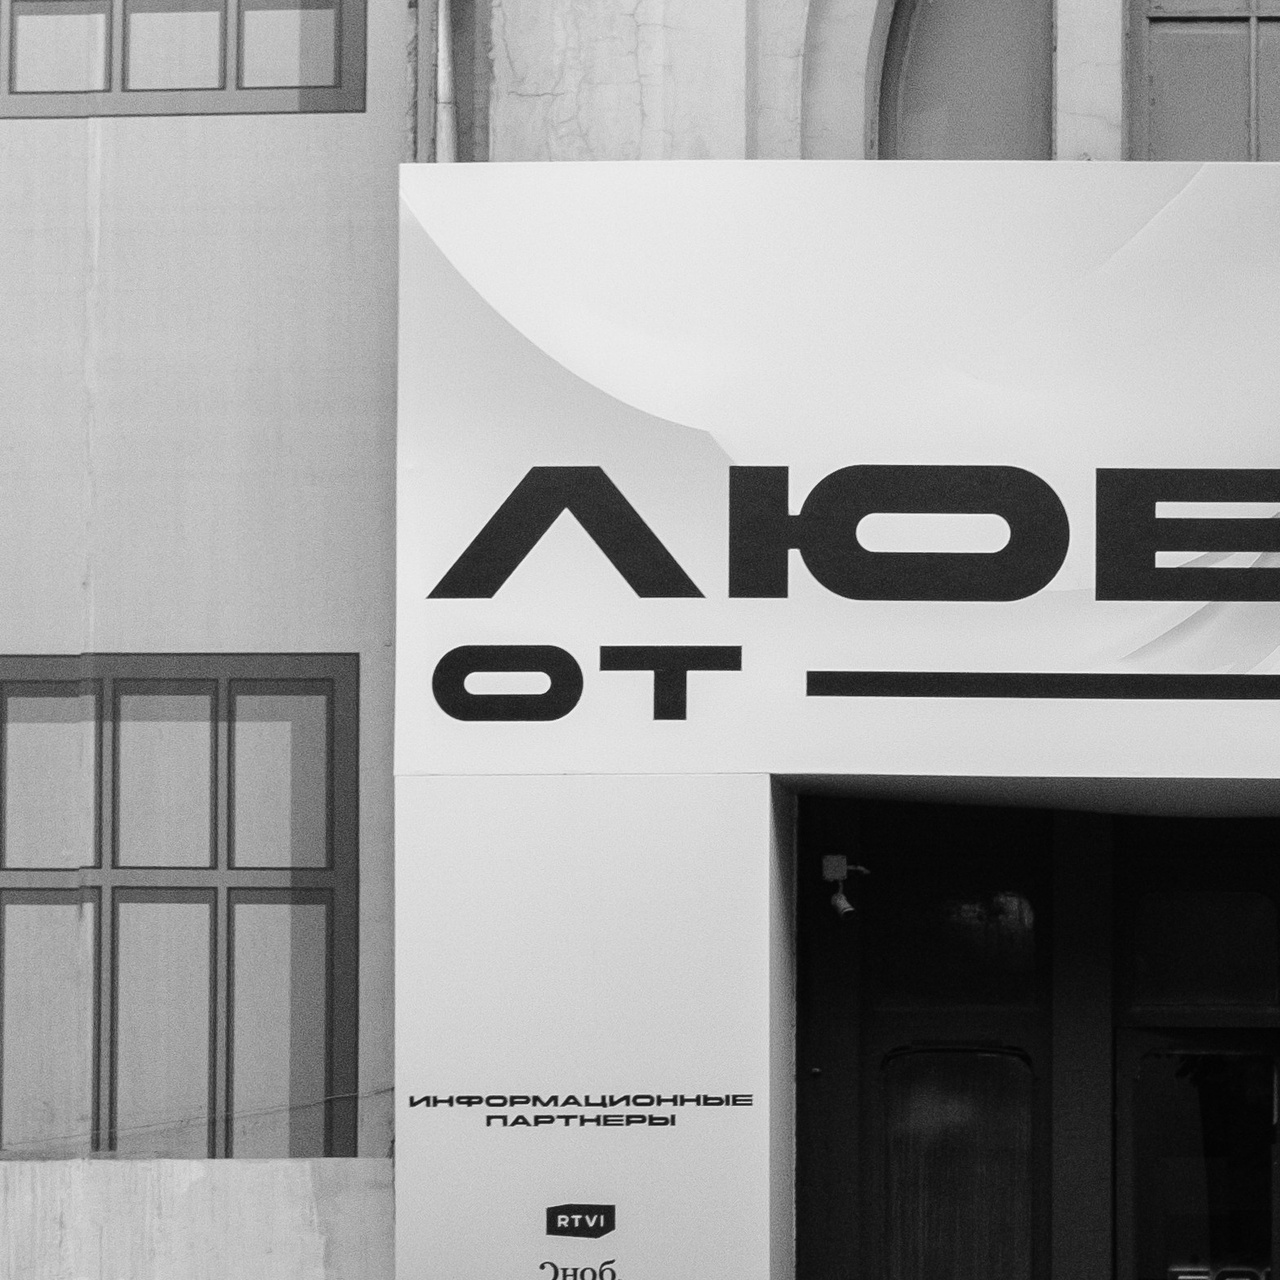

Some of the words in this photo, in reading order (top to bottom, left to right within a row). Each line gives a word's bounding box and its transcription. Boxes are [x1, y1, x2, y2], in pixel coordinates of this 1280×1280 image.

[431, 645, 743, 722] ОТ
[409, 1094, 753, 1108] ИНФОРМАЦИОННЫЕ
[485, 1114, 676, 1127] ПАРТНЕРЫ
[556, 1214, 605, 1228] RTVI
